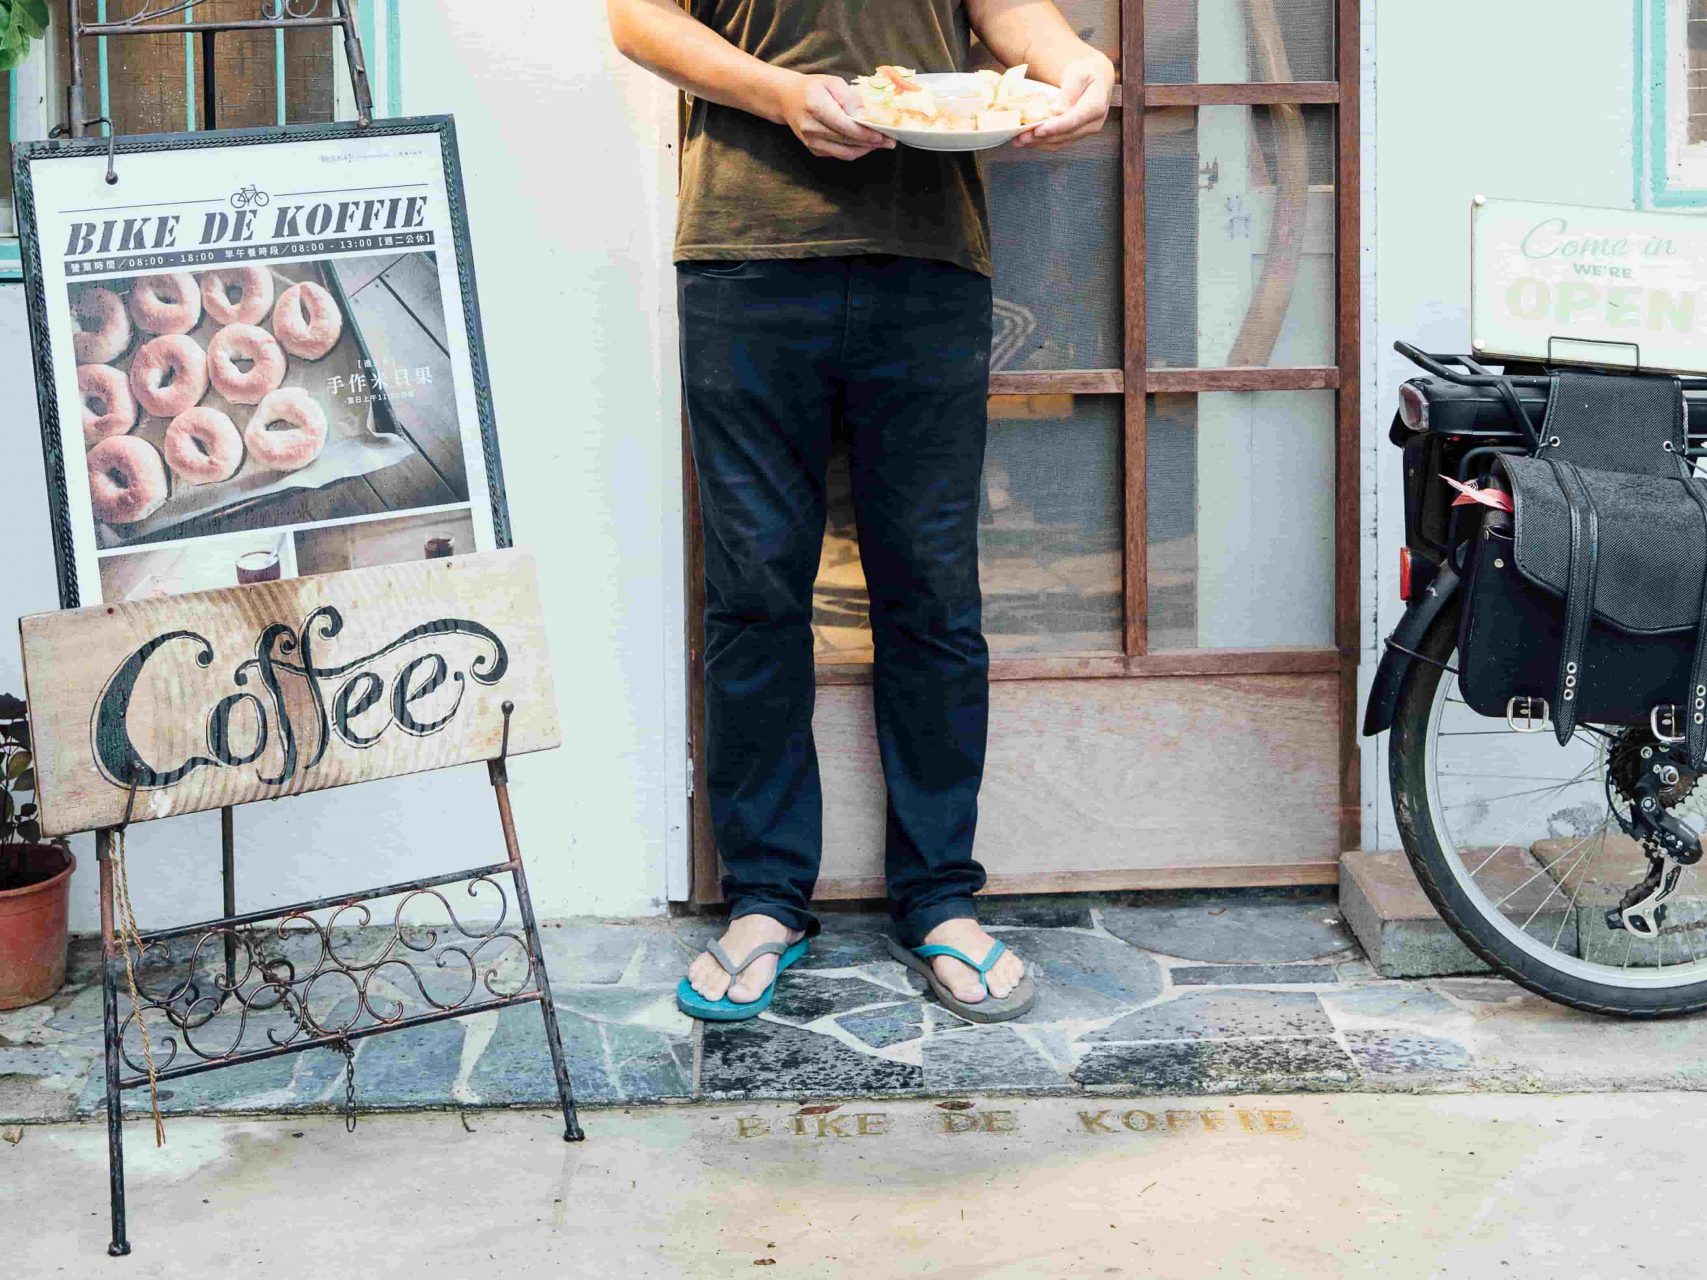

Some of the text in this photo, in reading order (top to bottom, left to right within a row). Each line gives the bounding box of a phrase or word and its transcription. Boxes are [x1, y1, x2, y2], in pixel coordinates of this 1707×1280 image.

[64, 195, 428, 257] BIKE DE KOFFIE
[1519, 216, 1677, 260] Come in
[180, 252, 215, 264] 18:00
[1572, 261, 1633, 279] WE'RE
[1505, 276, 1696, 334] OPEN
[90, 605, 509, 791] Coffee
[736, 1108, 1297, 1139] BIKE DE KOFFIE
